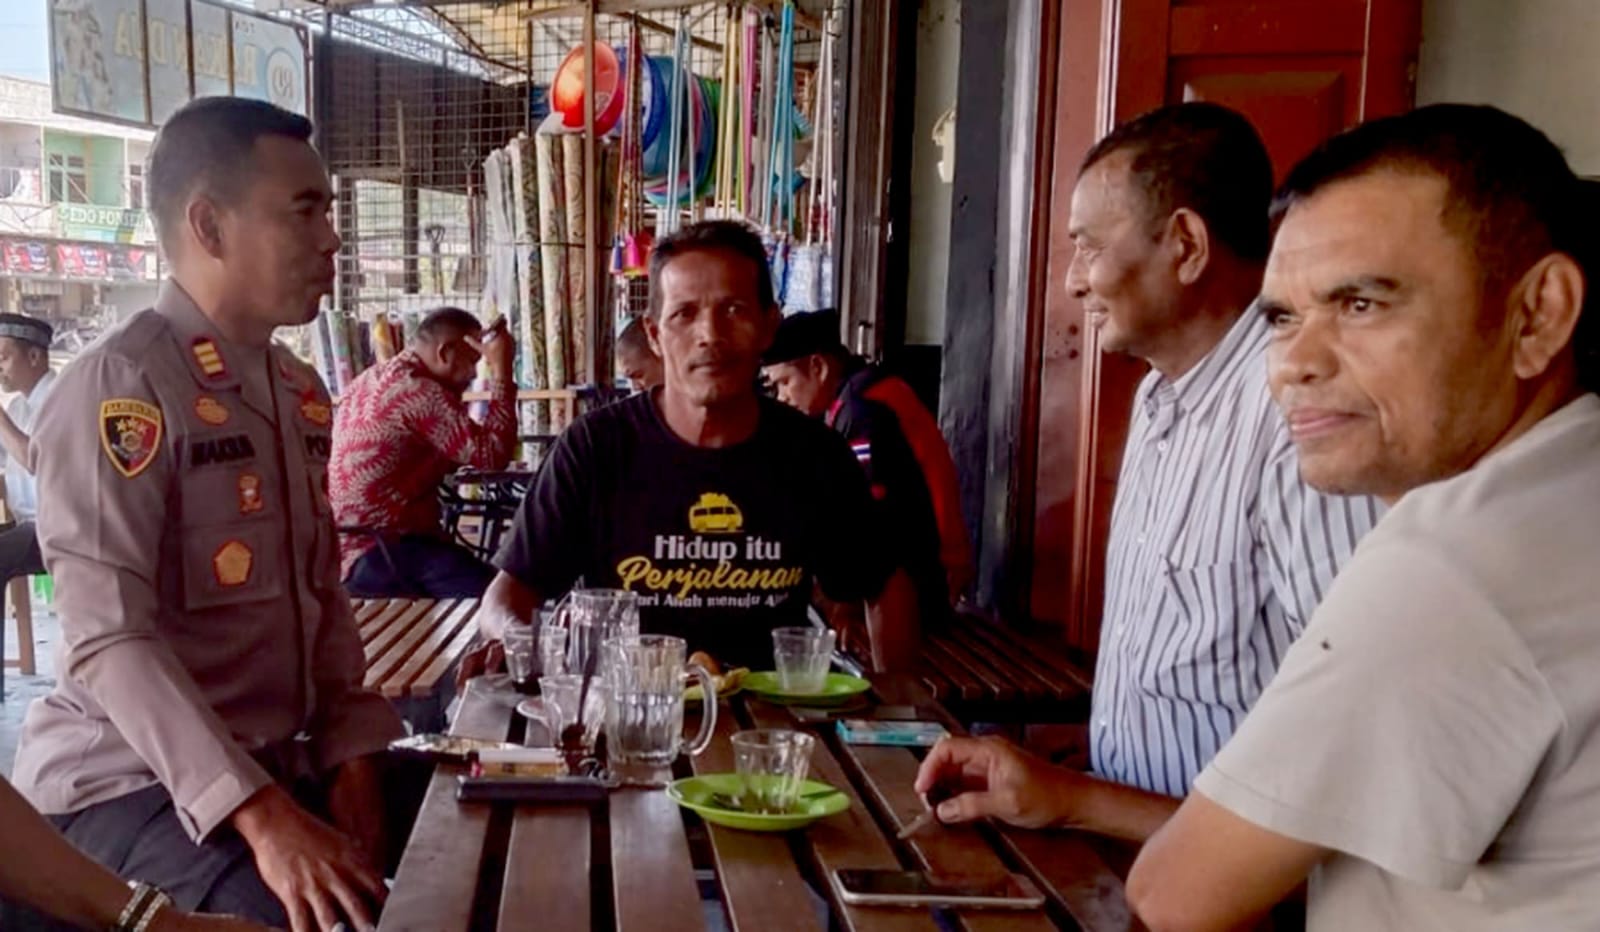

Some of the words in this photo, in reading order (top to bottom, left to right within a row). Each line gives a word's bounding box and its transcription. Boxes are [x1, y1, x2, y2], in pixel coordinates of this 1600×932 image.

[654, 534, 738, 564] Hidup
[745, 535, 782, 561] itu
[616, 555, 804, 600] Perjalanan
[636, 593, 659, 607] ari
